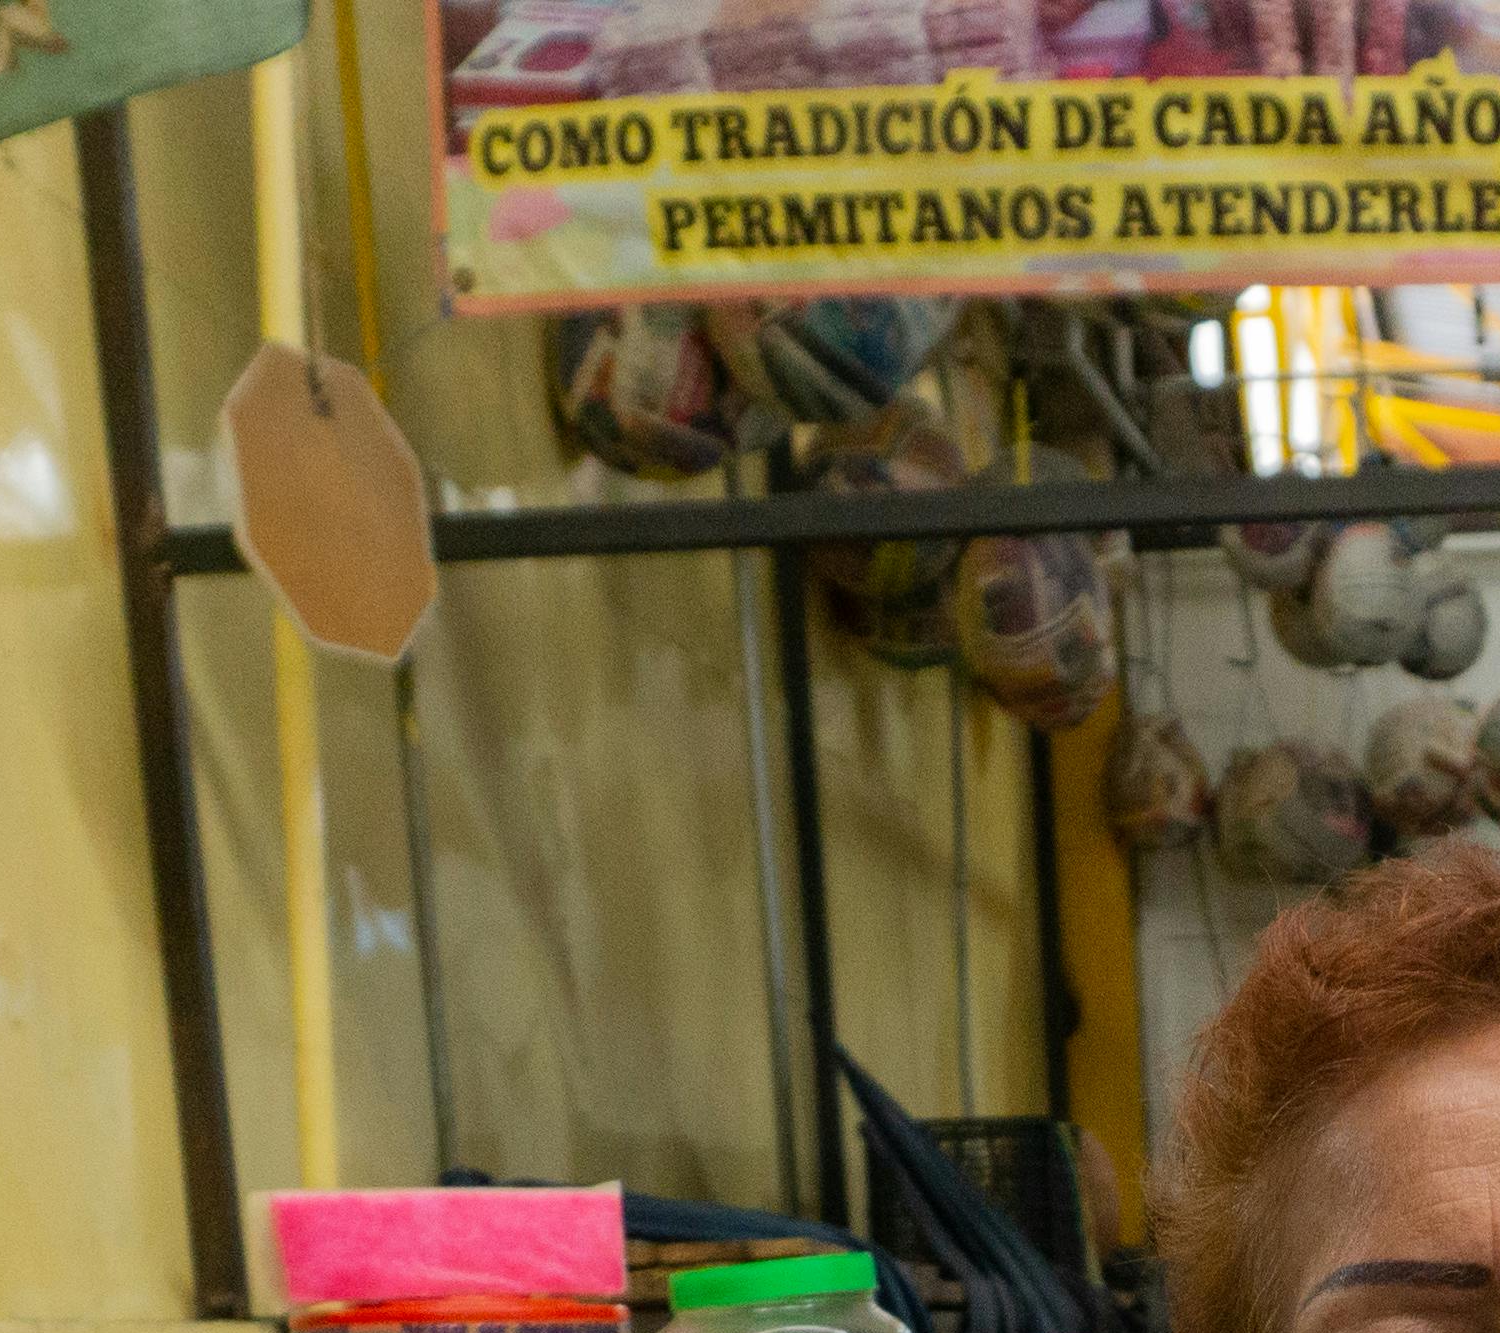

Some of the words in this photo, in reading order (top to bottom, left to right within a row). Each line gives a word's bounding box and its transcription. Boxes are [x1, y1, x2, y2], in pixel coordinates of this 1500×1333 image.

[481, 109, 656, 179] COMO
[671, 84, 1032, 164] TRADICIÓN
[1052, 95, 1136, 152] DE
[1152, 91, 1342, 150] CADA
[658, 185, 1096, 254] PERMITANOS
